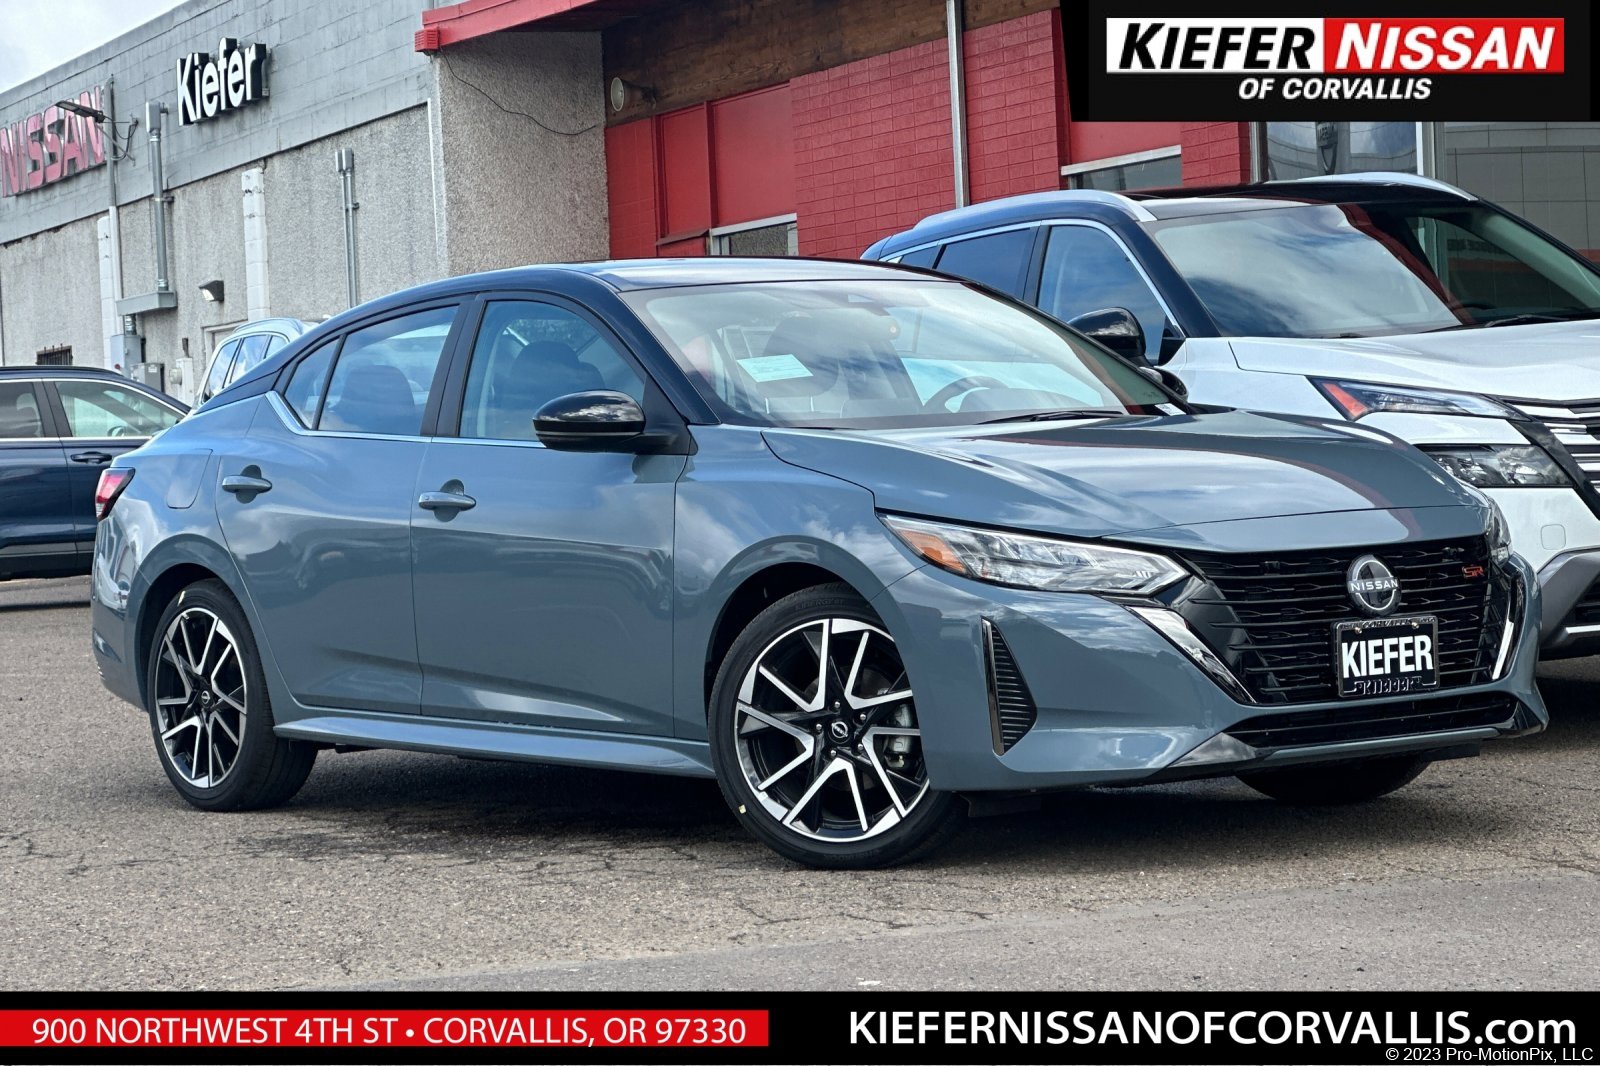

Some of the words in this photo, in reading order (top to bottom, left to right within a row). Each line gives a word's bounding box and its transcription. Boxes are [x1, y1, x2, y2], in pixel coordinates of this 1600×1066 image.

[177, 38, 264, 126] Kiefer
[0, 86, 104, 197] NISSAN
[1351, 578, 1399, 592] NISSAN
[1462, 566, 1485, 579] SR
[1342, 635, 1434, 678] KIEFER
